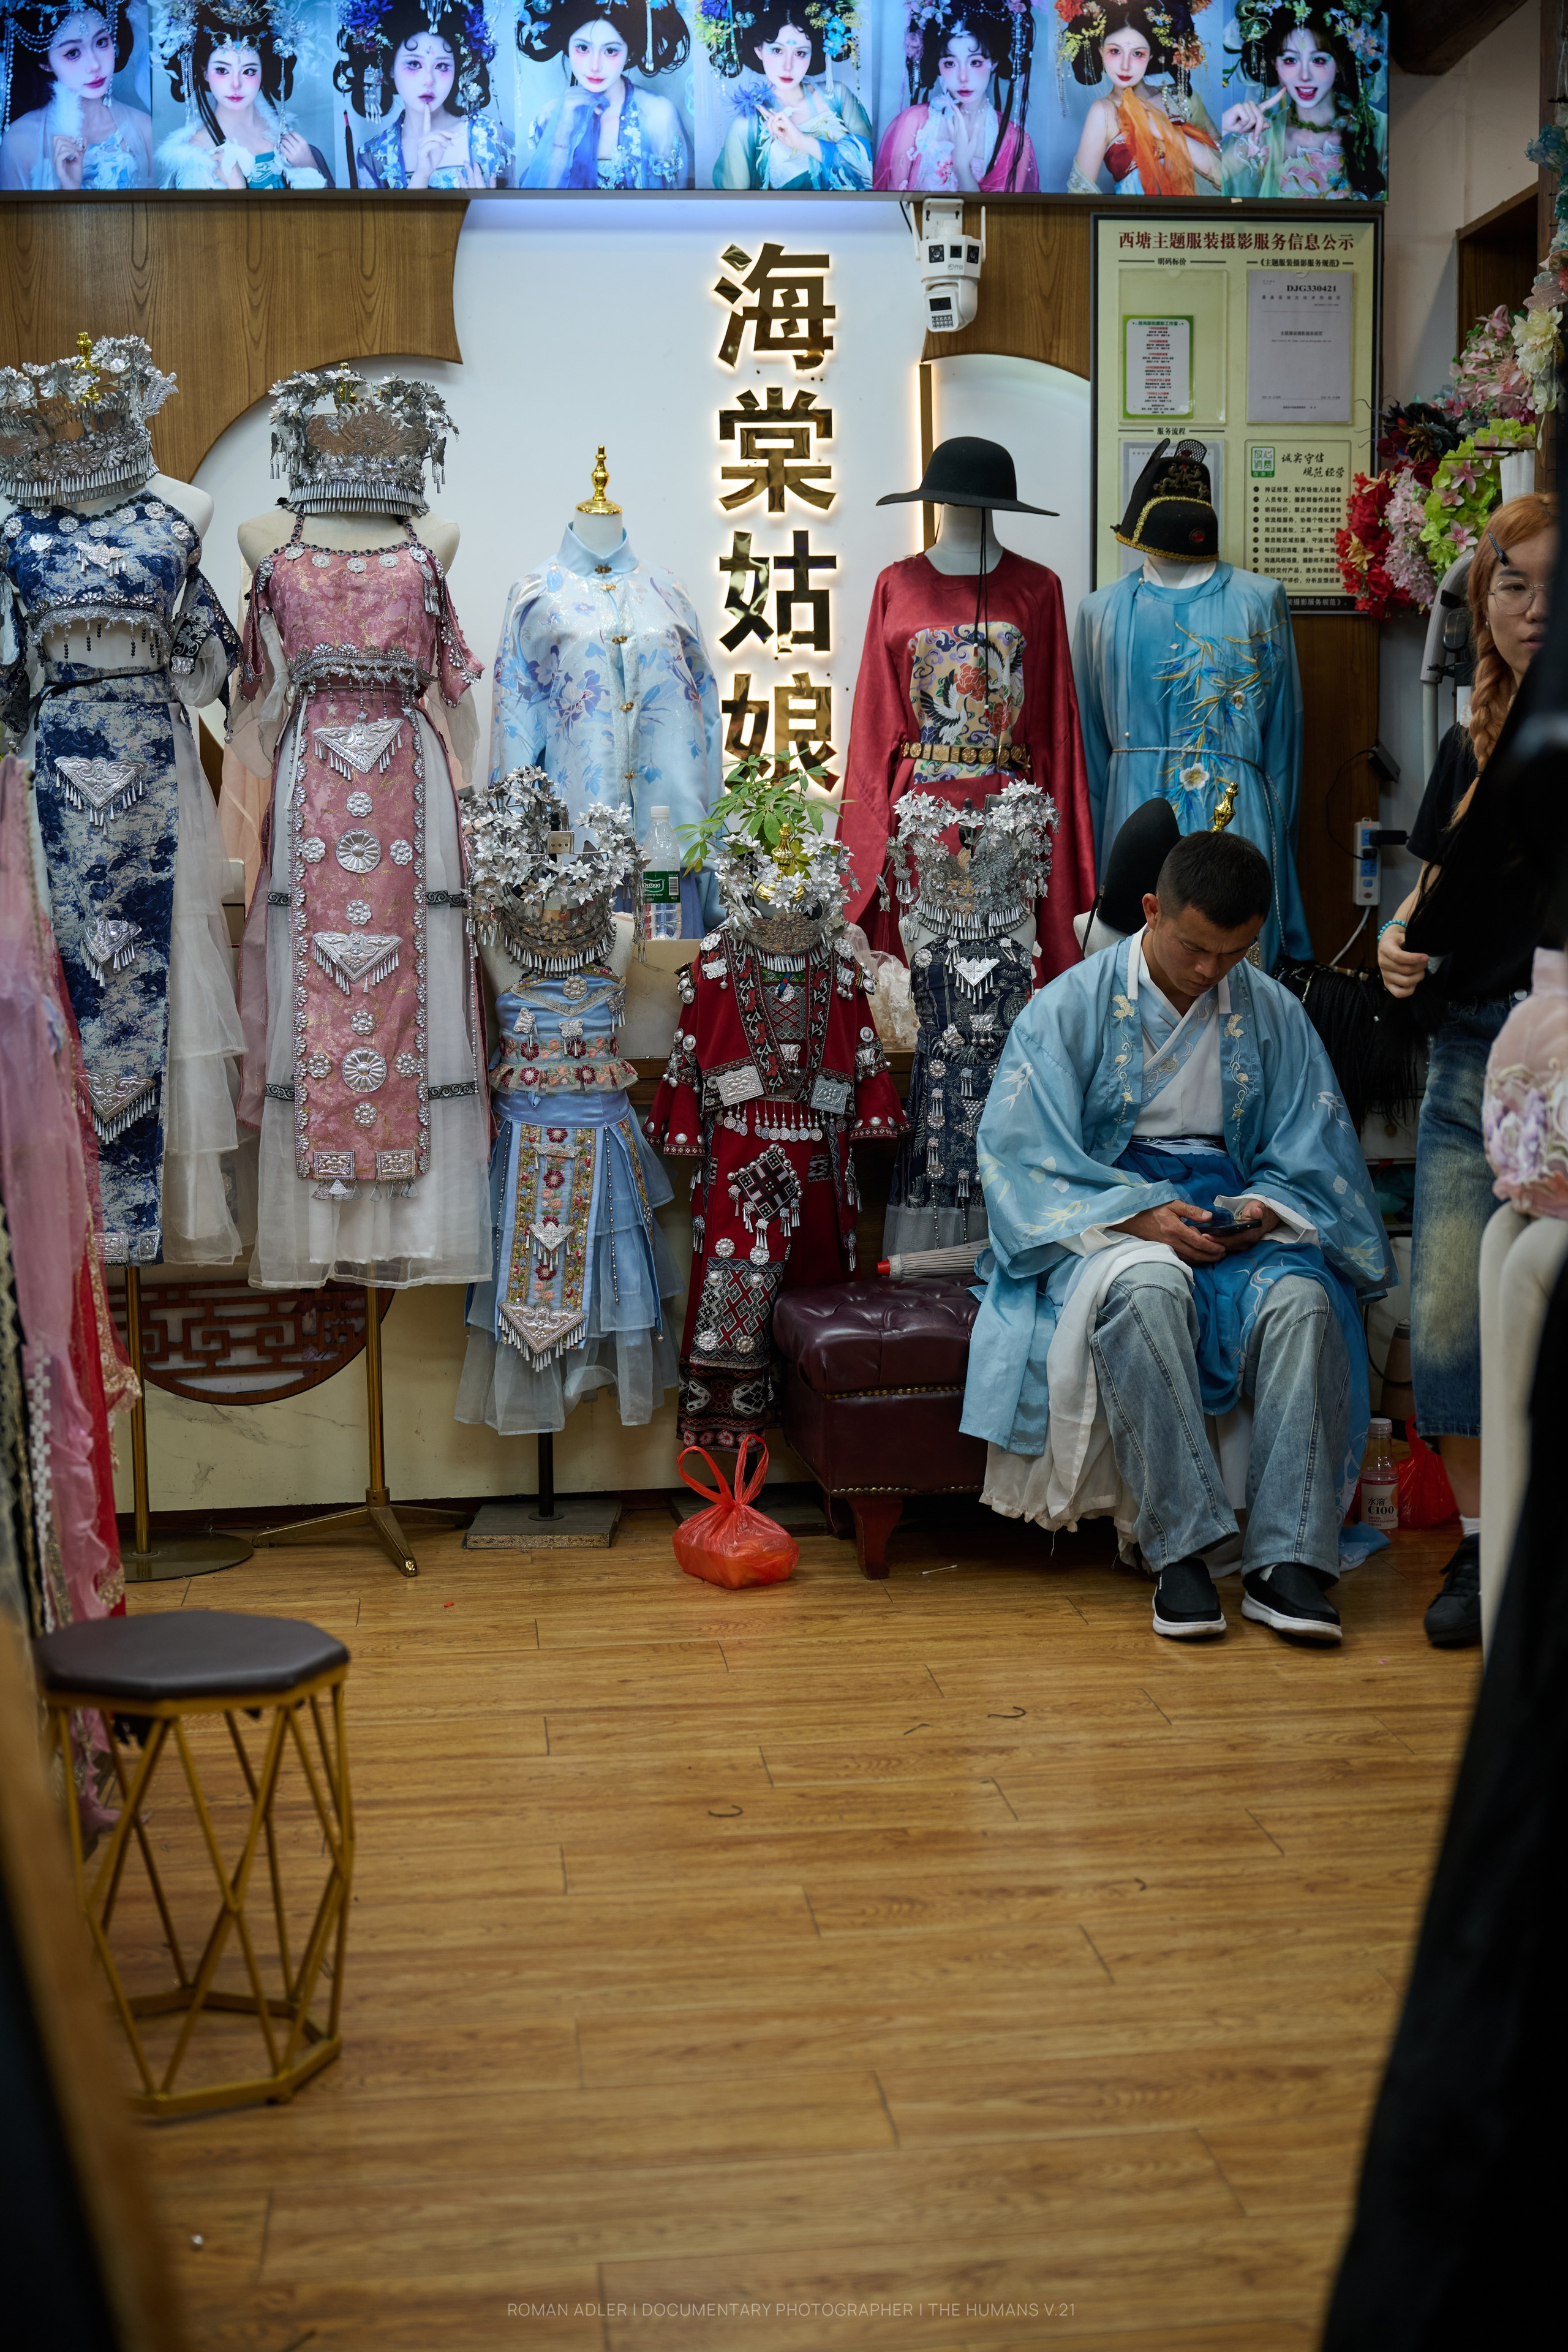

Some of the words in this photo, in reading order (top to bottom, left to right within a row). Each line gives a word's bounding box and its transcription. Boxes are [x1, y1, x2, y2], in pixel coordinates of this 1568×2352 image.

[1118, 232, 1354, 251] 西塘主题服装摄影服务信息公示
[1157, 257, 1186, 266] 明码标价
[1261, 258, 1340, 267] 《主题服装摄影服务规范》
[1281, 452, 1324, 464] 诚实守信
[1303, 467, 1344, 478] 规范经营
[713, 243, 840, 793] 海棠姑娘
